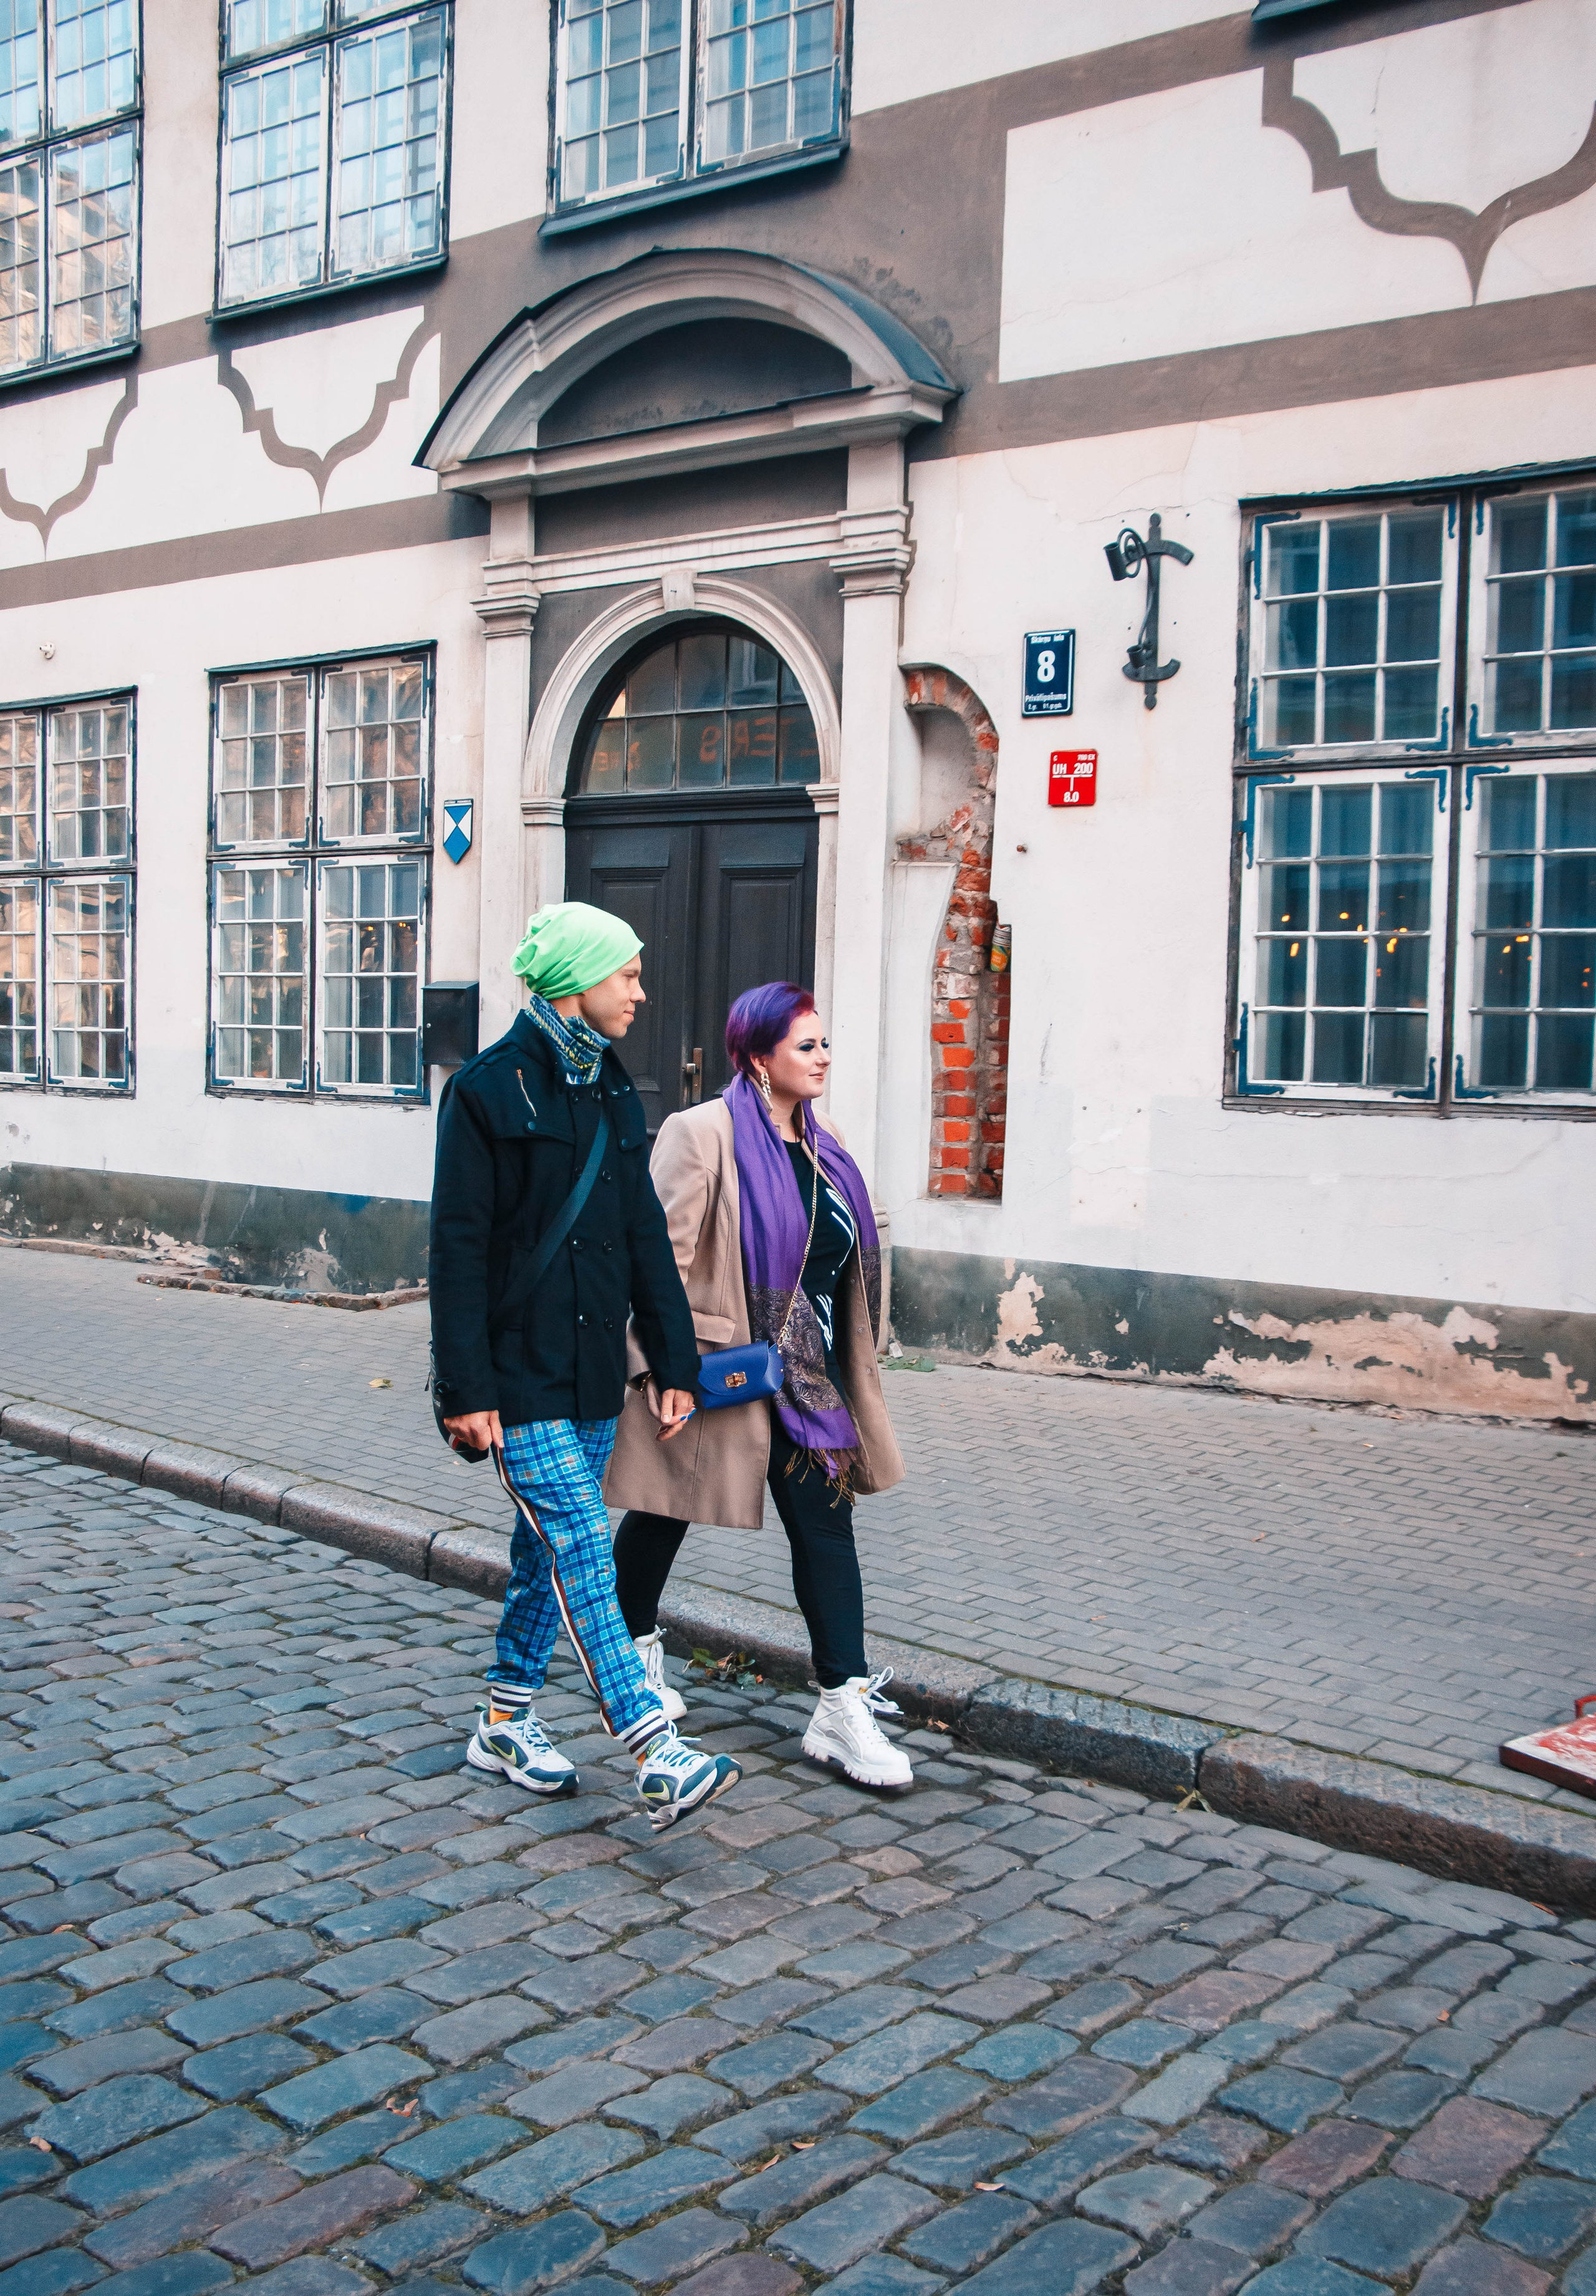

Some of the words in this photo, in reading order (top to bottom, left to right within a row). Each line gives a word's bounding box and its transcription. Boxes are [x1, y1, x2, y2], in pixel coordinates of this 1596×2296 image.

[1037, 650, 1055, 683] 8
[1052, 763, 1067, 774] UH
[1074, 762, 1094, 774] 200
